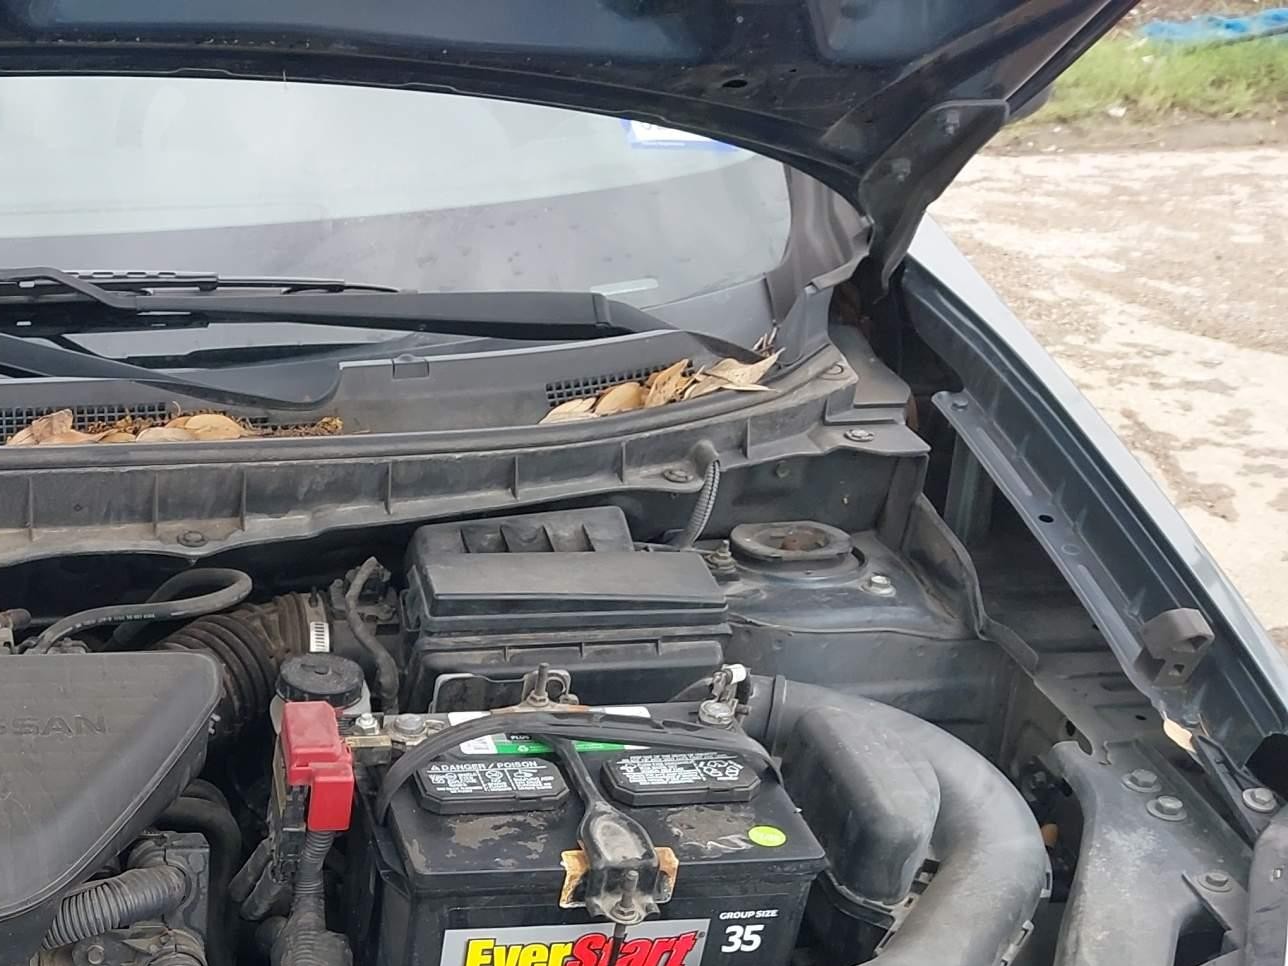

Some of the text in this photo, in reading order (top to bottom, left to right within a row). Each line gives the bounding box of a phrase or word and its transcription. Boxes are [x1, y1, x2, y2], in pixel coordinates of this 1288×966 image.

[440, 763, 486, 771] DANGER
[496, 761, 538, 769] POISON
[719, 909, 779, 920] GROUP SIZE
[721, 924, 765, 953] 35
